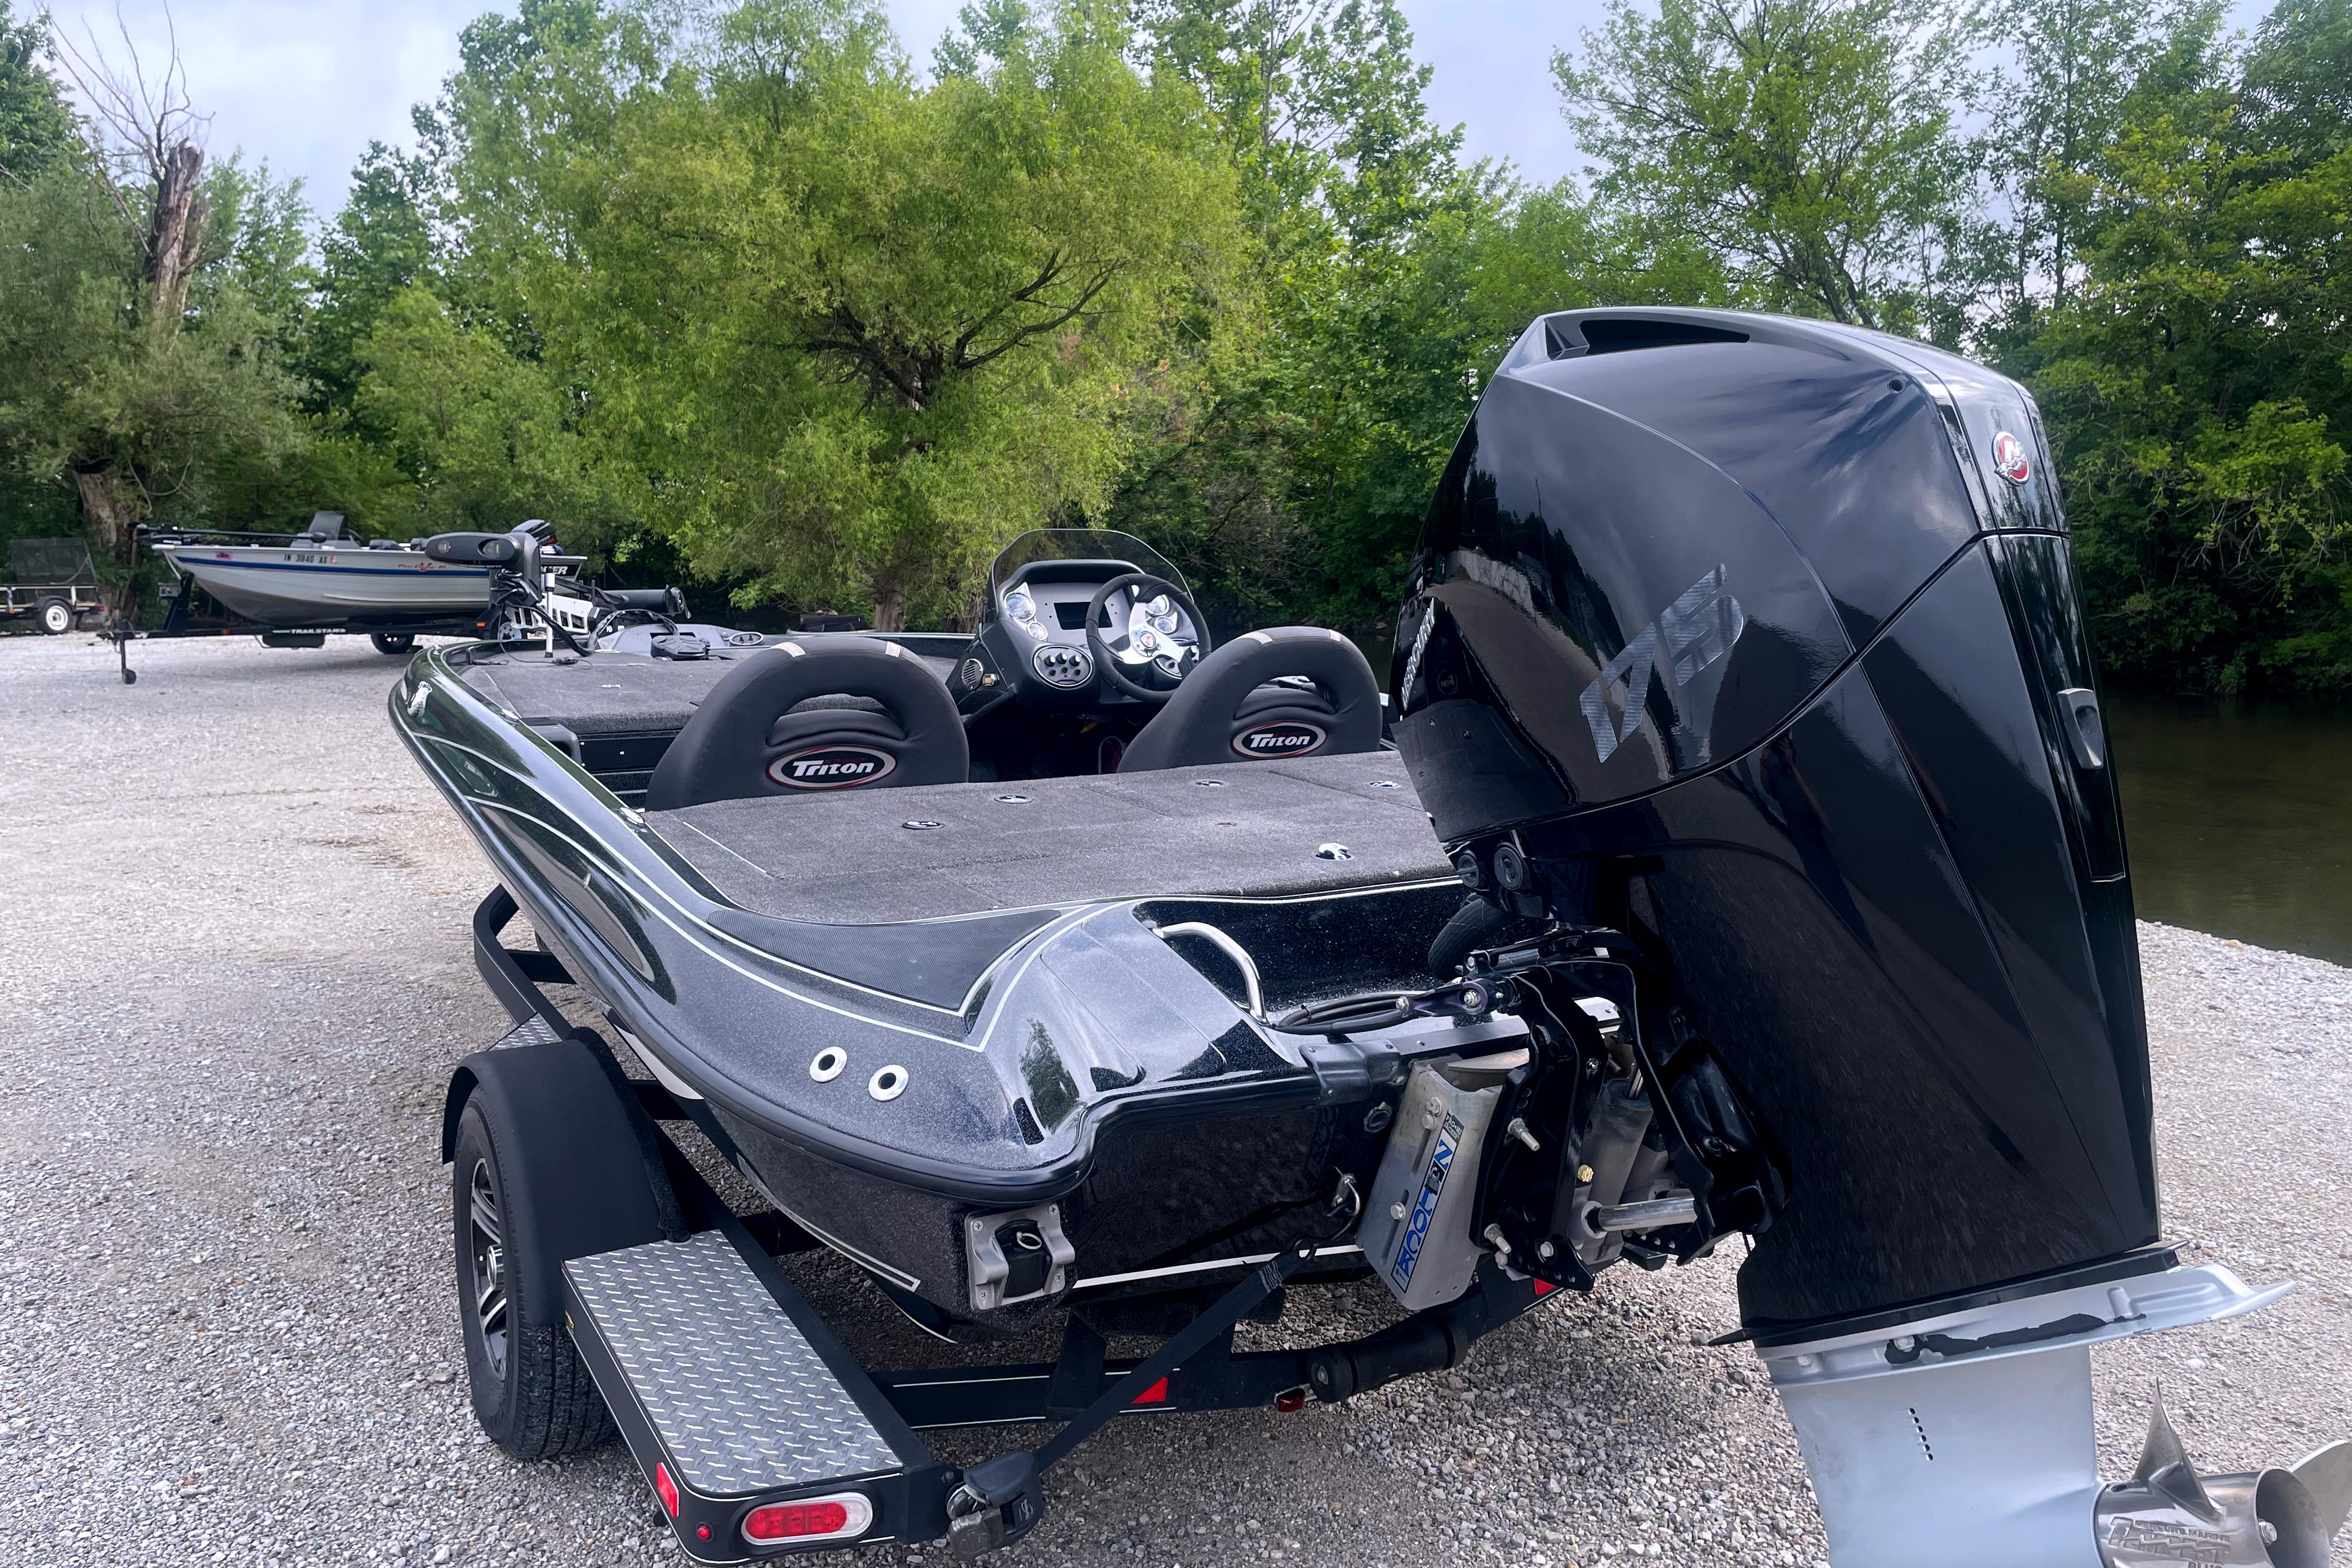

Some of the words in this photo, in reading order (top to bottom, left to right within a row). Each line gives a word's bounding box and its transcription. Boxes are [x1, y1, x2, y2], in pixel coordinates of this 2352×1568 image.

[1401, 597, 1435, 711] MERCURY
[1580, 563, 1744, 763] 175
[792, 760, 874, 777] Triton
[1250, 733, 1310, 748] Triton
